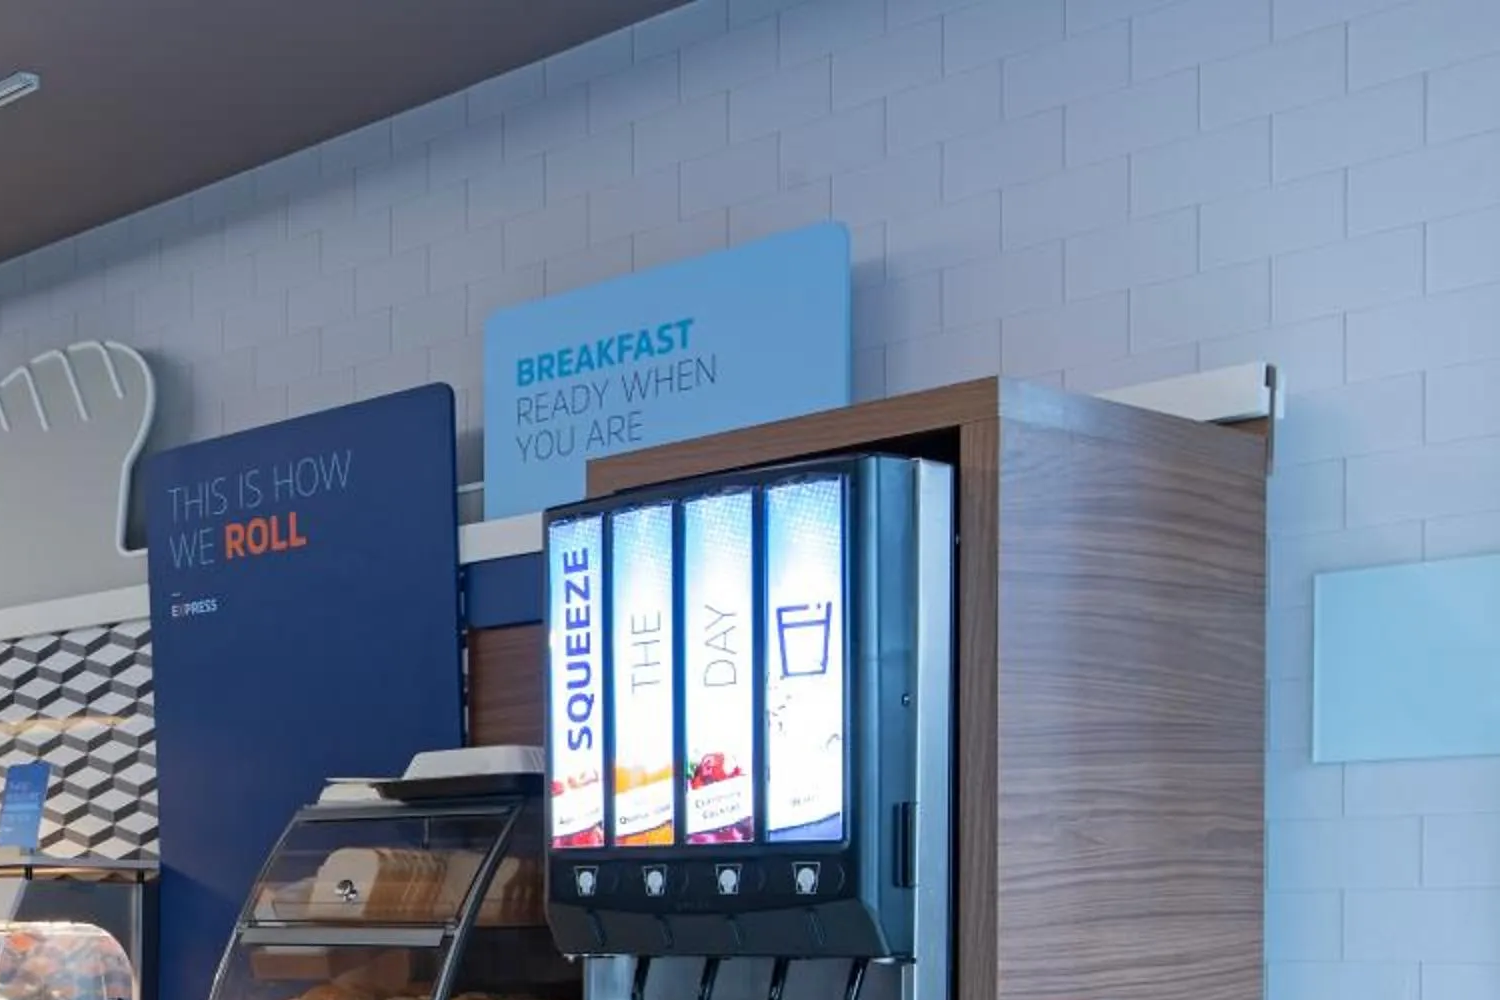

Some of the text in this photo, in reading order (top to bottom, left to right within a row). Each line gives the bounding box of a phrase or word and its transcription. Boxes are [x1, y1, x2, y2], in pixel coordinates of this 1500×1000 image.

[516, 318, 695, 388] BREAKFAST
[516, 353, 717, 425] READY WHEN
[516, 411, 642, 463] YOU ARE
[168, 450, 352, 523] THIS IS HOW
[169, 512, 306, 568] WE ROLL
[563, 547, 594, 752] SQUEEZE
[630, 610, 662, 694] THE
[703, 604, 738, 687] DAY
